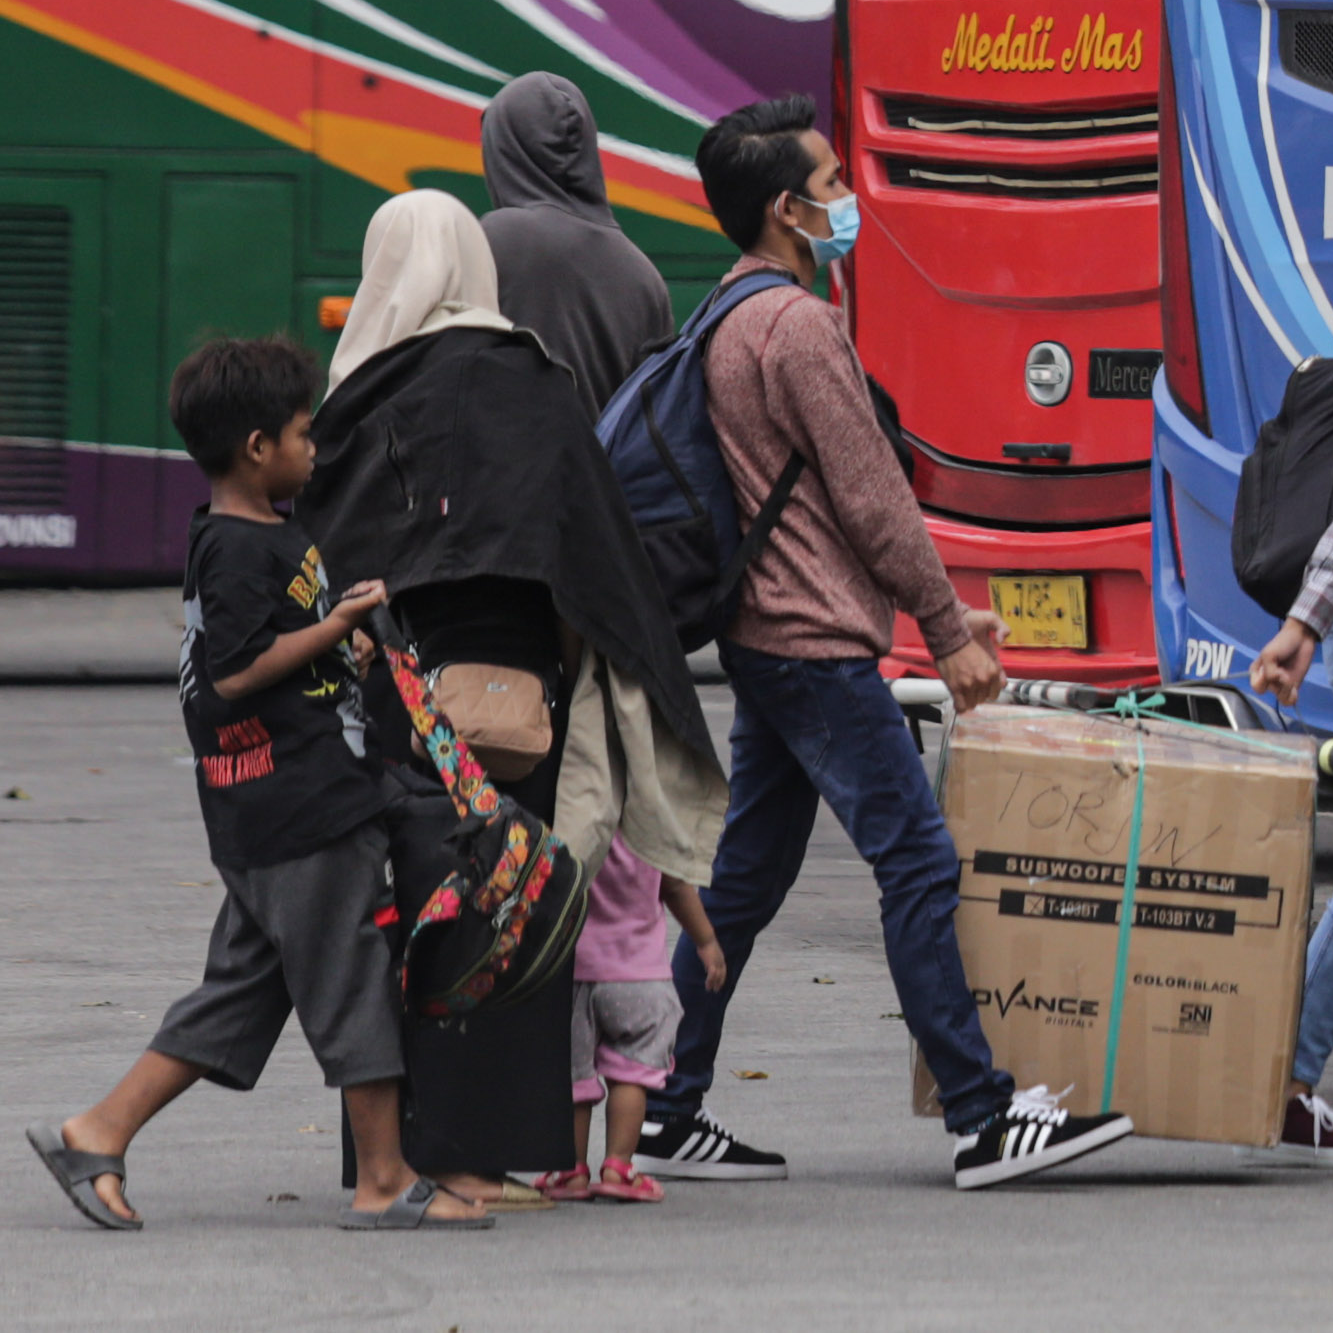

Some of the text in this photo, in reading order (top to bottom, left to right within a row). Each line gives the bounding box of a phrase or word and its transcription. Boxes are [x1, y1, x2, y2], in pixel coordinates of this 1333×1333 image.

[942, 11, 1144, 73] Medali Mas
[1185, 639, 1236, 679] PDW
[1005, 856, 1237, 893] SUBWOOFE SYSTEM
[1139, 909, 1191, 927] T-103BT
[1194, 914, 1215, 930] V.2
[968, 977, 1099, 1020] DVANCE
[1179, 1003, 1213, 1025] SNI
